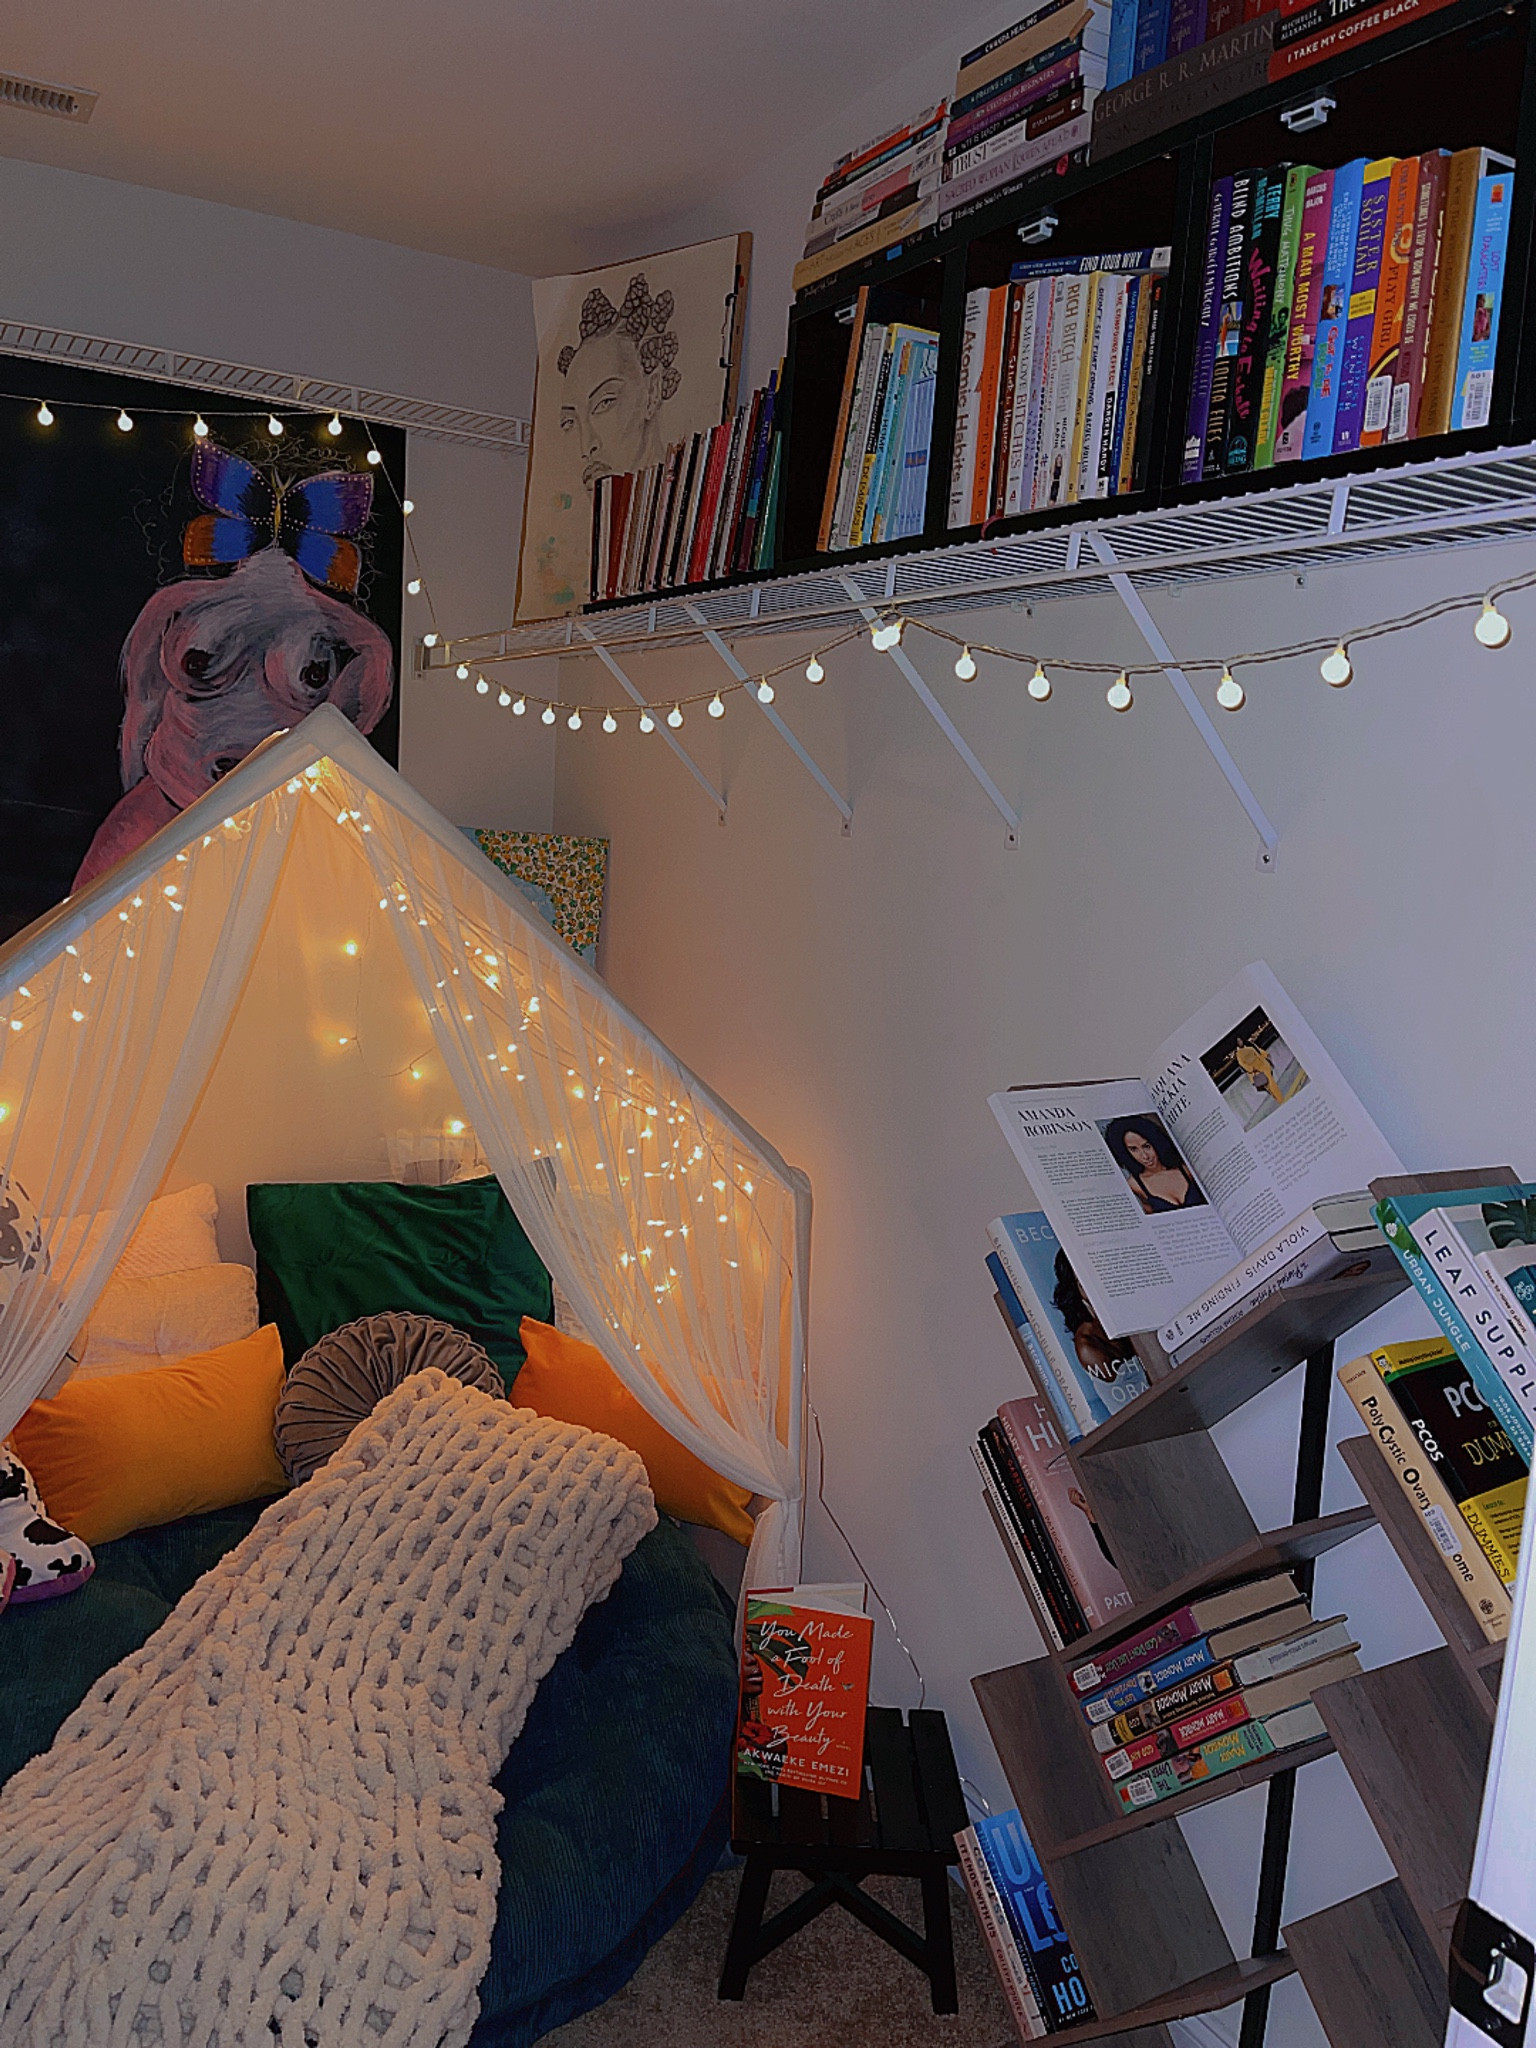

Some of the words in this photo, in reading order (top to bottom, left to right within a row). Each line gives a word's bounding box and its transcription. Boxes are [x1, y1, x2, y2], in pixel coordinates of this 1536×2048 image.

[1280, 8, 1318, 31] MICHELLE
[1280, 15, 1322, 40] ALEXANDER
[1287, 53, 1292, 63] I
[1293, 40, 1319, 61] TAKE
[1320, 33, 1336, 49] MY
[1338, 13, 1381, 40] COFFEE
[1382, 0, 1420, 21] BLACK
[1094, 79, 1152, 122] GEORGE
[1158, 70, 1174, 91] R.
[1178, 62, 1193, 82] R.
[1197, 26, 1275, 71] MARTIN
[1230, 178, 1249, 219] BLIND
[1265, 182, 1282, 219] TERRY
[1283, 210, 1296, 240] THUG
[1303, 232, 1316, 242] A
[1355, 197, 1374, 277] SOULJAH
[1369, 194, 1386, 272] SISTER
[1078, 256, 1099, 272] FIND
[1099, 253, 1122, 270] YOUR
[1122, 250, 1143, 268] WHY
[1222, 224, 1245, 300] AMBITIONS
[1274, 242, 1290, 304] MATRIMONY
[1299, 246, 1314, 278] MAN
[1066, 282, 1080, 318] RICH
[1115, 289, 1123, 305] THE
[1244, 248, 1271, 334] Waiting
[1293, 281, 1310, 320] MOST
[1386, 266, 1400, 304] FLYY
[1026, 291, 1035, 322] WHY
[1023, 324, 1032, 354] MEN
[1060, 322, 1077, 364] BITCH
[1112, 308, 1121, 353] COMPOUND
[1380, 309, 1393, 348] GIRL
[1286, 323, 1304, 380] WORTHY
[960, 331, 977, 408] Atomic
[1019, 355, 1030, 390] LOVE
[1108, 355, 1118, 386] EFFECT
[1210, 360, 1230, 403] LOLITA
[1344, 337, 1359, 411] WINTER
[1088, 372, 1097, 405] COMING
[1233, 355, 1253, 419] Exhale
[1320, 378, 1331, 399] BE
[1010, 394, 1027, 469] BITCHES
[1103, 396, 1114, 436] DARREN
[1206, 409, 1225, 443] FILES
[879, 419, 889, 452] HOME
[953, 414, 969, 482] Habits
[977, 432, 990, 498] POWER
[1099, 438, 1110, 472] HARDY
[1017, 1106, 1076, 1122] AMANDA
[1023, 1120, 1093, 1137] ROBINSON
[1274, 1225, 1308, 1253] VIOLA
[1245, 1253, 1276, 1278] DAVIS
[1424, 1229, 1478, 1298] LEAF
[1201, 1278, 1241, 1311] FINDING
[1402, 1249, 1435, 1295] URBAN
[1432, 1299, 1471, 1353] JUNGLE
[994, 1236, 1023, 1293] BECOMING
[1026, 1309, 1057, 1368] MICHELLE
[1054, 1367, 1078, 1411] OBAMA
[1188, 1309, 1202, 1324] ME
[1360, 1395, 1407, 1465] PolyCystic
[1403, 1468, 1433, 1511] Ovary
[1411, 1418, 1445, 1462] PCOS
[1002, 1415, 1021, 1452] HEART
[1022, 1464, 1045, 1506] HUSTLE
[1044, 1515, 1063, 1555] PATRICIA
[1006, 1458, 1033, 1510] GABRIELLE
[1466, 1512, 1511, 1579] DUMMIES
[759, 1620, 797, 1650] You
[797, 1620, 855, 1642] Made
[770, 1653, 781, 1663] a
[784, 1646, 822, 1667] Fool
[827, 1650, 846, 1674] of
[1153, 1661, 1184, 1683] MONROE
[1181, 1650, 1206, 1669] MARY
[773, 1673, 837, 1698] Death
[1155, 1686, 1187, 1711] MONROE
[1186, 1676, 1212, 1694] MARY
[767, 1699, 802, 1716] with
[804, 1701, 849, 1731] Your
[1178, 1718, 1204, 1737] MONROE
[1204, 1709, 1225, 1725] MARY
[766, 1725, 835, 1756] Beauty
[1202, 1732, 1240, 1756] MONROE
[1219, 1744, 1246, 1763] MARY
[743, 1747, 806, 1767] AKWAEKE
[811, 1761, 849, 1777] EMEZI
[1149, 1761, 1173, 1782] UPPER
[1155, 1777, 1172, 1793] THE
[973, 1846, 1005, 1926] CONFESS
[959, 1843, 967, 1857] IT
[963, 1857, 979, 1889] ENDS
[975, 1888, 991, 1921] WITH
[985, 1920, 997, 1938] US
[996, 1948, 1013, 1988] COLLEEN
